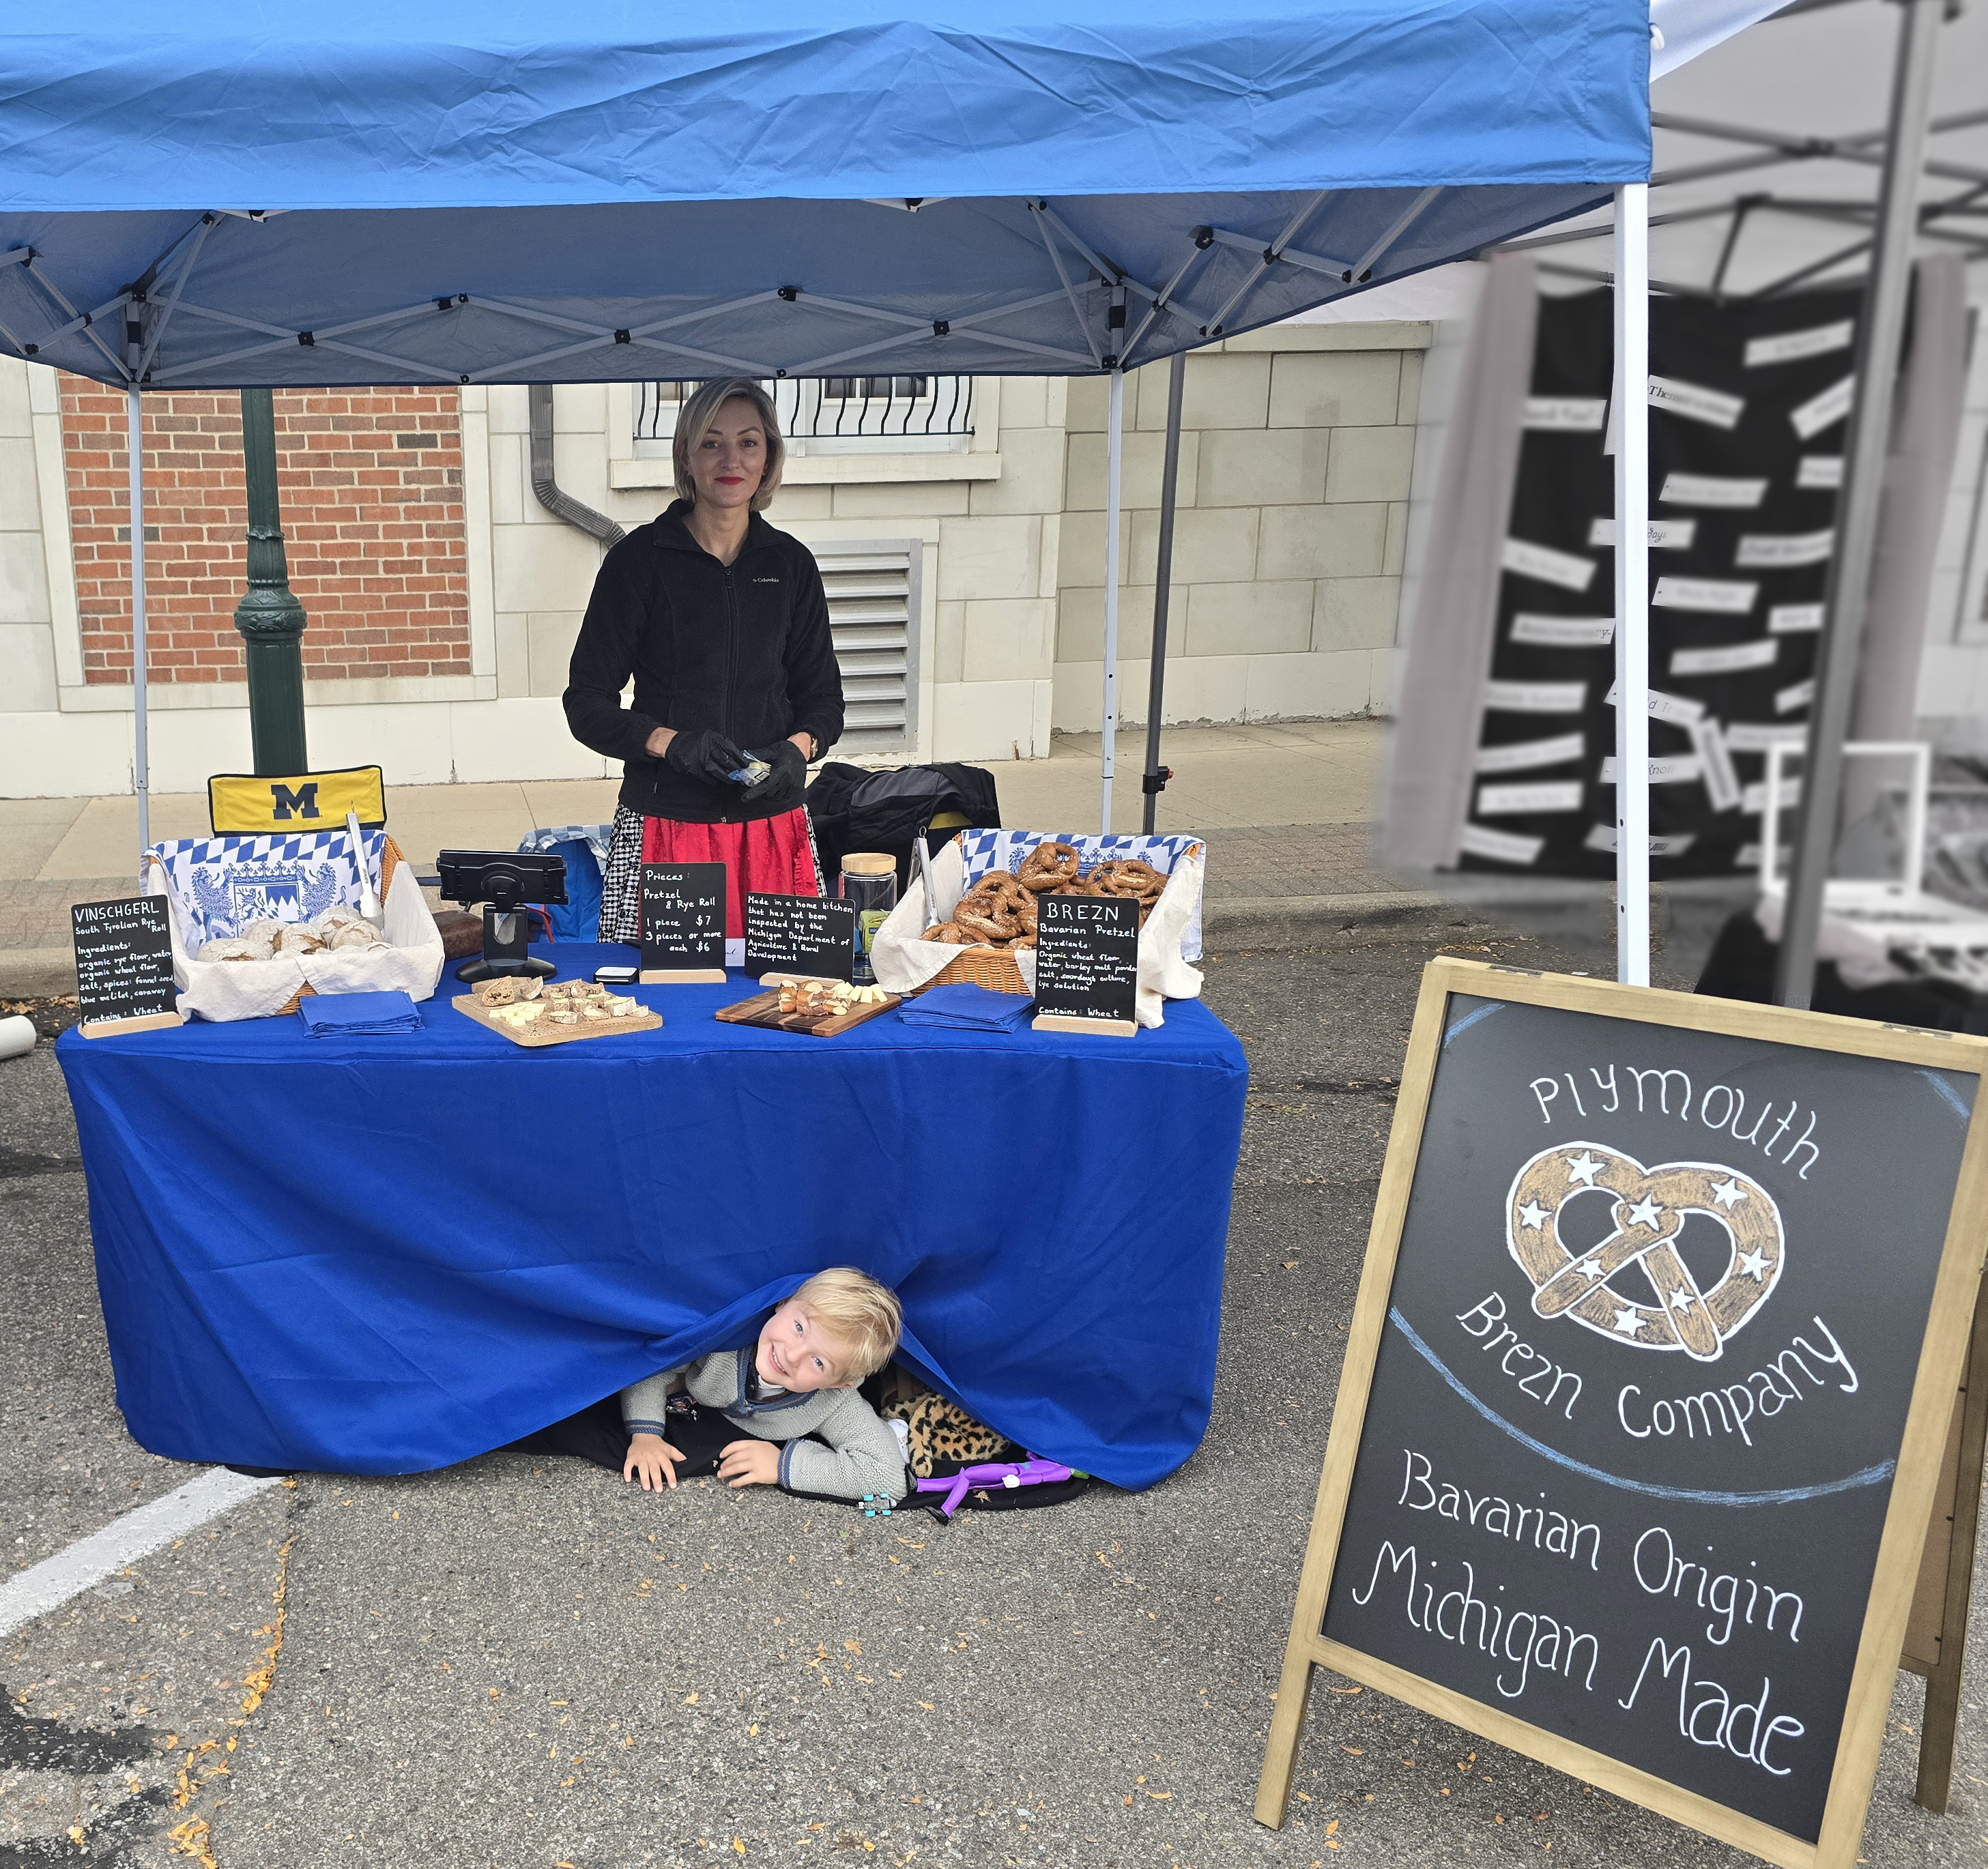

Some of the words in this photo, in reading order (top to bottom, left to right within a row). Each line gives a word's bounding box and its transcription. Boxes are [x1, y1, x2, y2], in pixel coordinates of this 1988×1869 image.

[271, 783, 320, 820] M
[644, 888, 680, 899] Pretzel
[75, 901, 160, 923] VINSCHGERL
[677, 900, 695, 912] Rye
[699, 897, 716, 906] Roll
[748, 895, 769, 905] Made
[796, 900, 818, 910] home
[822, 901, 853, 914] kitchen
[1047, 903, 1119, 921] BREZN
[748, 907, 764, 916] that
[770, 909, 784, 917] has
[791, 911, 804, 919] not
[75, 925, 100, 935] South
[103, 921, 138, 933] Tyrolian
[141, 918, 156, 928] Rye
[152, 923, 167, 932] Roll
[646, 918, 650, 927] 1
[655, 920, 681, 930] piece
[695, 915, 711, 927] $7
[748, 917, 788, 928] inspected
[795, 922, 805, 934] by
[809, 923, 824, 931] the
[646, 931, 653, 941] 3
[657, 934, 682, 945] pieces
[748, 928, 782, 941] Michigan
[788, 931, 836, 944] Department
[1040, 923, 1086, 934] Bavarian
[1095, 925, 1135, 938] Pretzel
[669, 944, 688, 953] each
[696, 941, 710, 953] $6
[748, 939, 788, 951] Agriculture
[747, 950, 797, 961] Development
[1039, 951, 1067, 961] Organic
[1071, 952, 1095, 961] wheat
[78, 959, 111, 970] organic
[114, 957, 127, 966] rye
[1065, 962, 1091, 974] barley
[80, 970, 111, 981] organic
[115, 966, 136, 974] wheat
[1061, 973, 1096, 985] sourdough
[80, 982, 102, 991] salt,
[135, 976, 157, 985] fennel
[1054, 983, 1090, 991] solution
[81, 996, 96, 1004] blue
[134, 988, 166, 996] caraway
[134, 1004, 162, 1015] Wheat
[1088, 1008, 1119, 1017] Wheat
[1529, 1063, 1823, 1180] Plymouth
[1456, 1292, 1582, 1419] Brezn
[1617, 1315, 1859, 1448] Company
[1398, 1449, 1601, 1571] Bavarian
[1633, 1527, 1804, 1645] Origin
[1351, 1540, 1600, 1698] Michigan
[1617, 1637, 1806, 1776] Made
